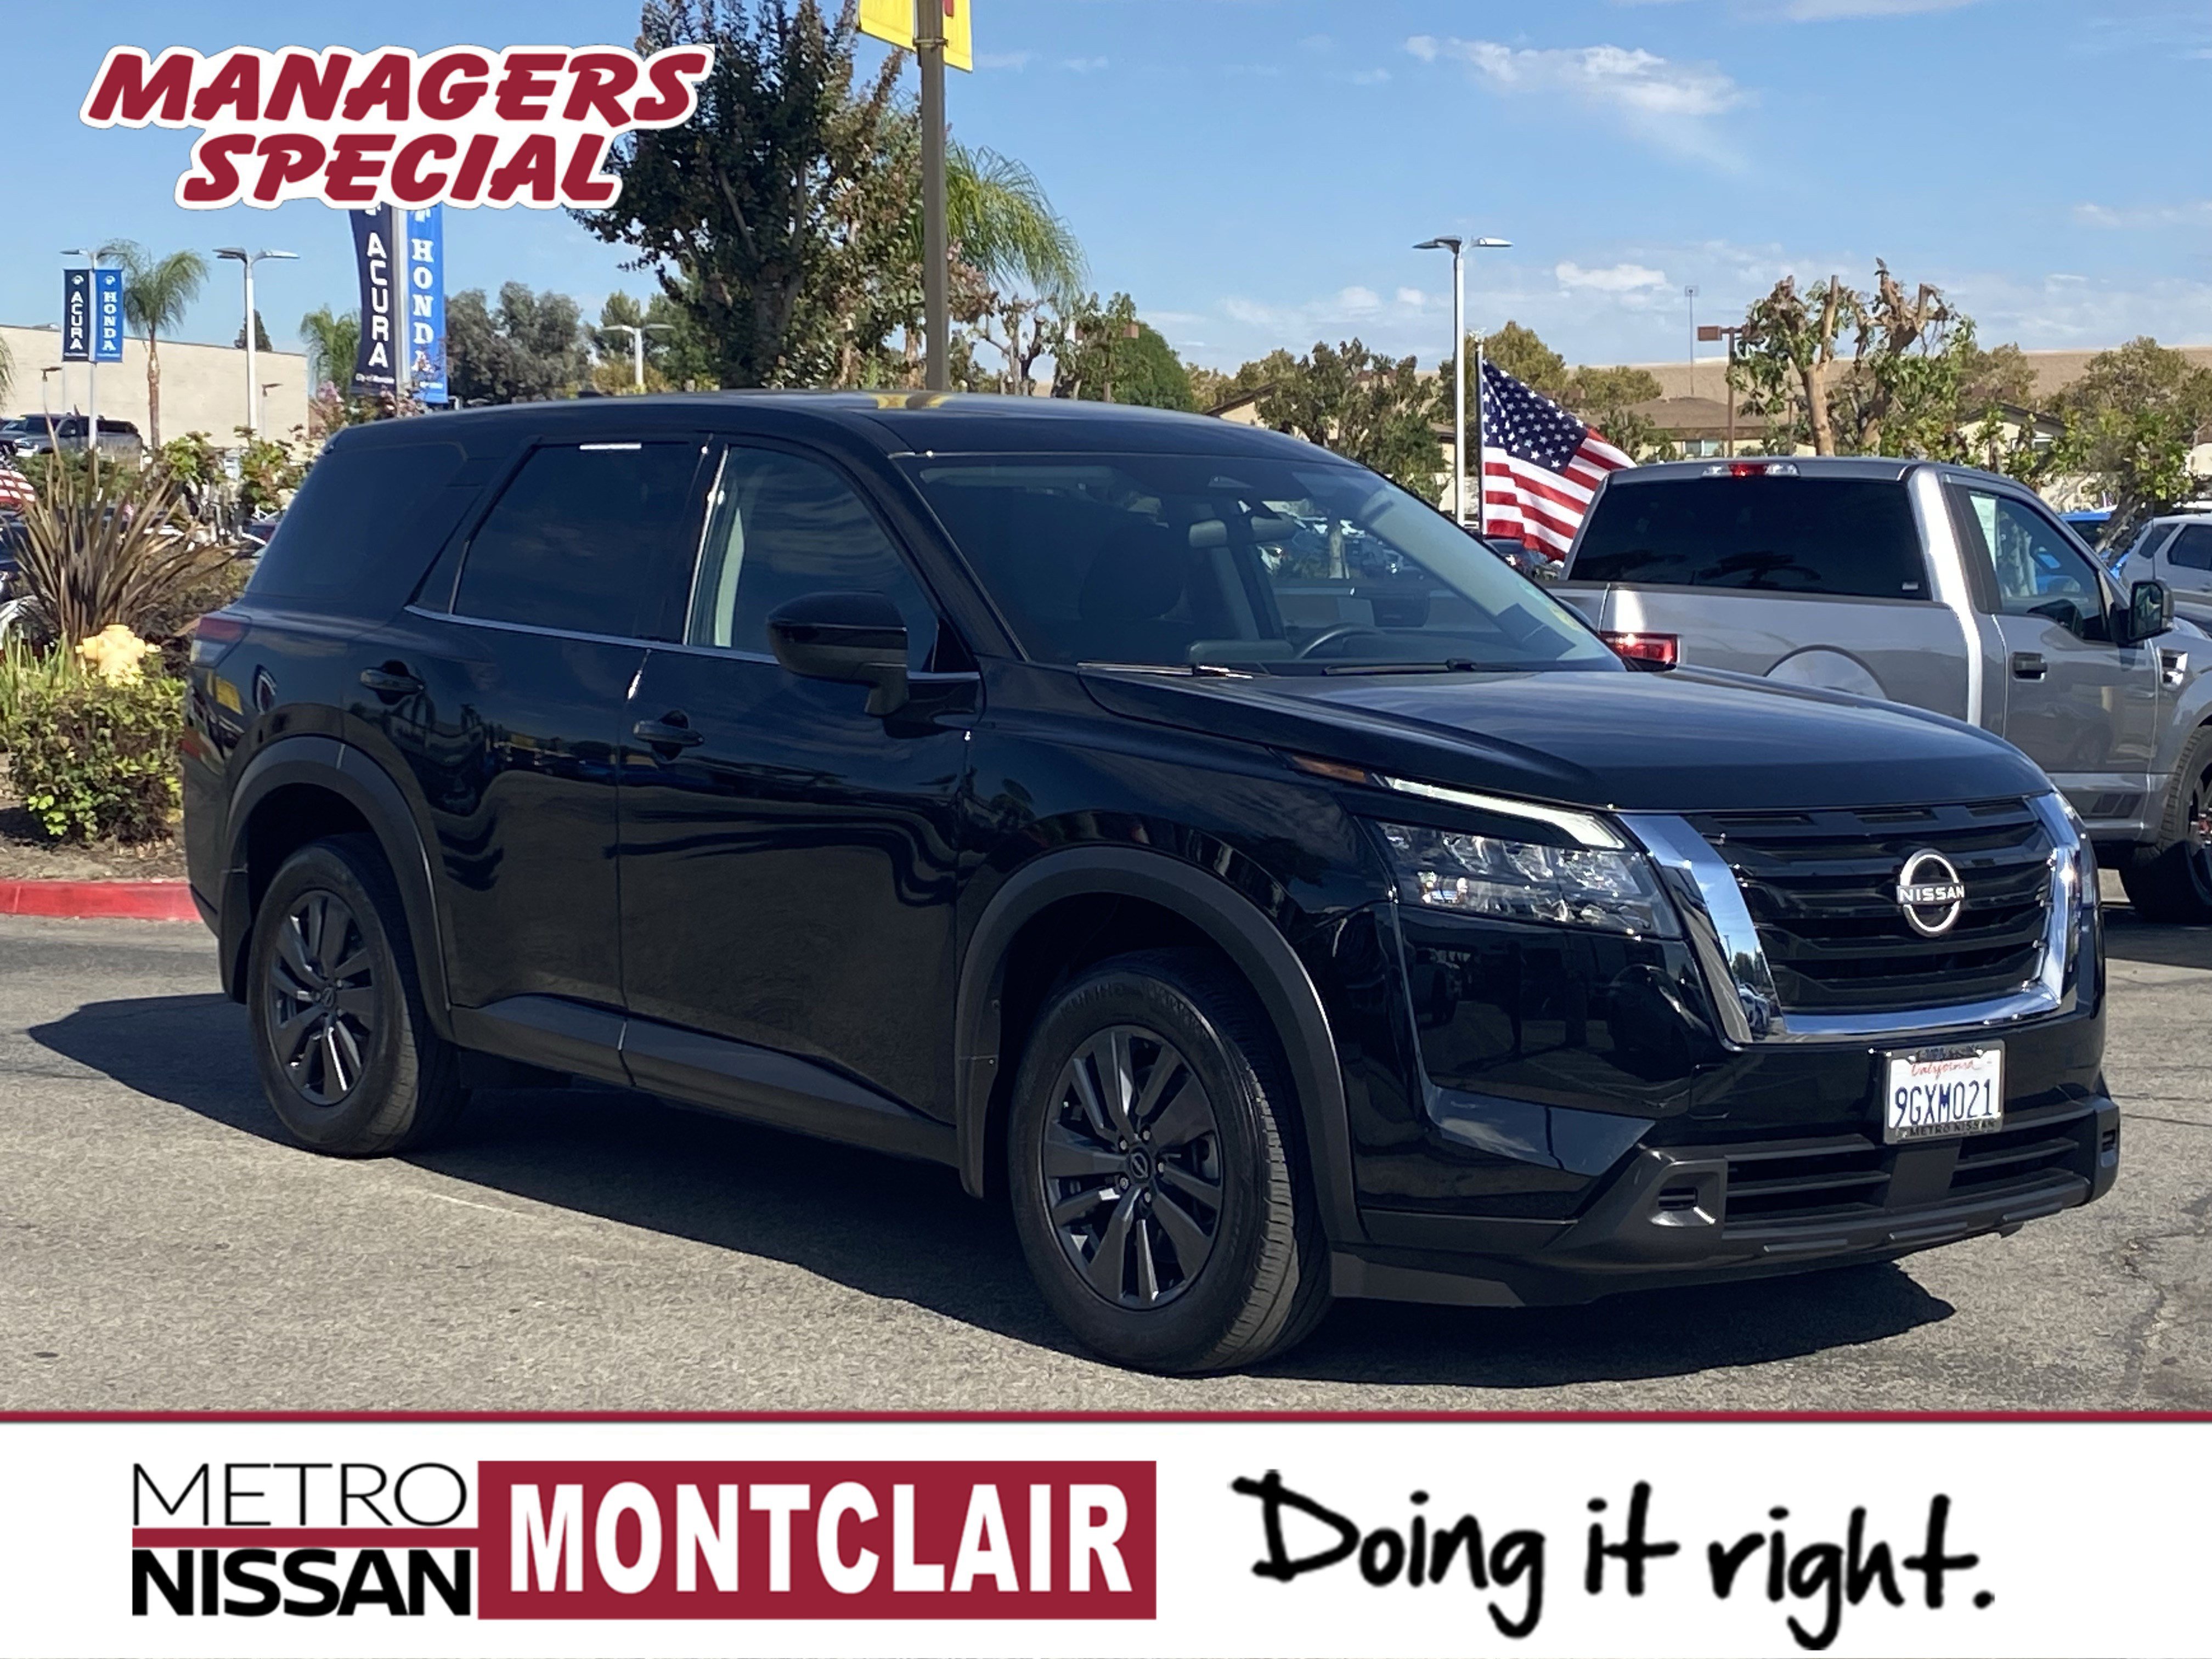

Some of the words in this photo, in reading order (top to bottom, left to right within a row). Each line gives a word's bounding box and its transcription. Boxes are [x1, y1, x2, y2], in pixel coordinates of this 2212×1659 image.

[70, 291, 83, 349] ACURA
[102, 291, 117, 351] HONDA
[366, 232, 388, 368] ACURA
[411, 238, 435, 372] HONDA
[1899, 885, 1965, 901] NISSAN
[1894, 1078, 1993, 1127] 9GXM021
[1910, 1122, 1950, 1136] METRO
[1954, 1120, 1995, 1132] NISSAN
